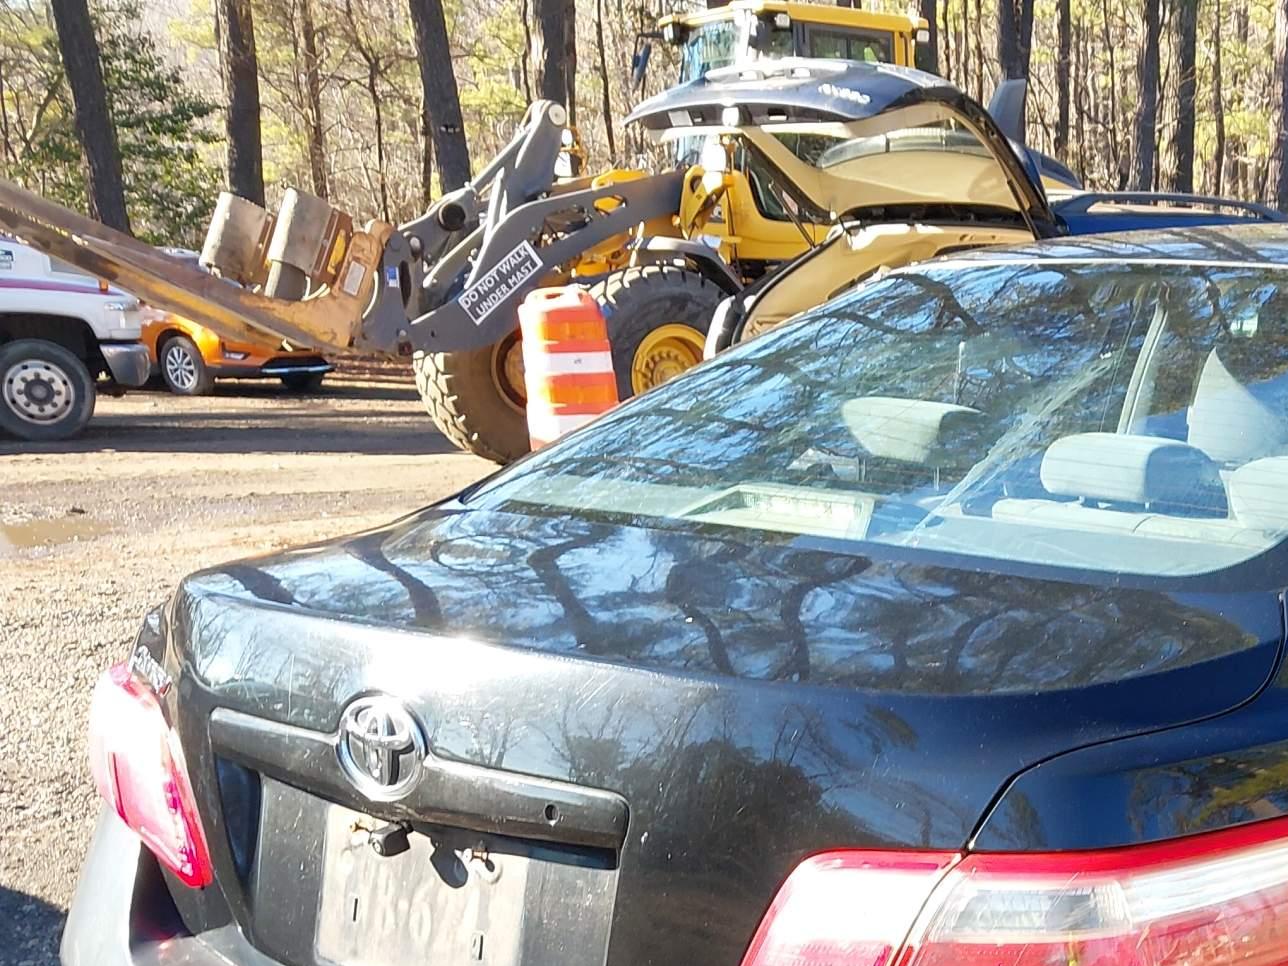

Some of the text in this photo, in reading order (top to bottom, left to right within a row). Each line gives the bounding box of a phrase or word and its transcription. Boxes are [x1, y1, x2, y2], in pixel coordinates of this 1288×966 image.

[462, 247, 529, 308] DO NOT WALK
[476, 261, 533, 315] UNDER MAST
